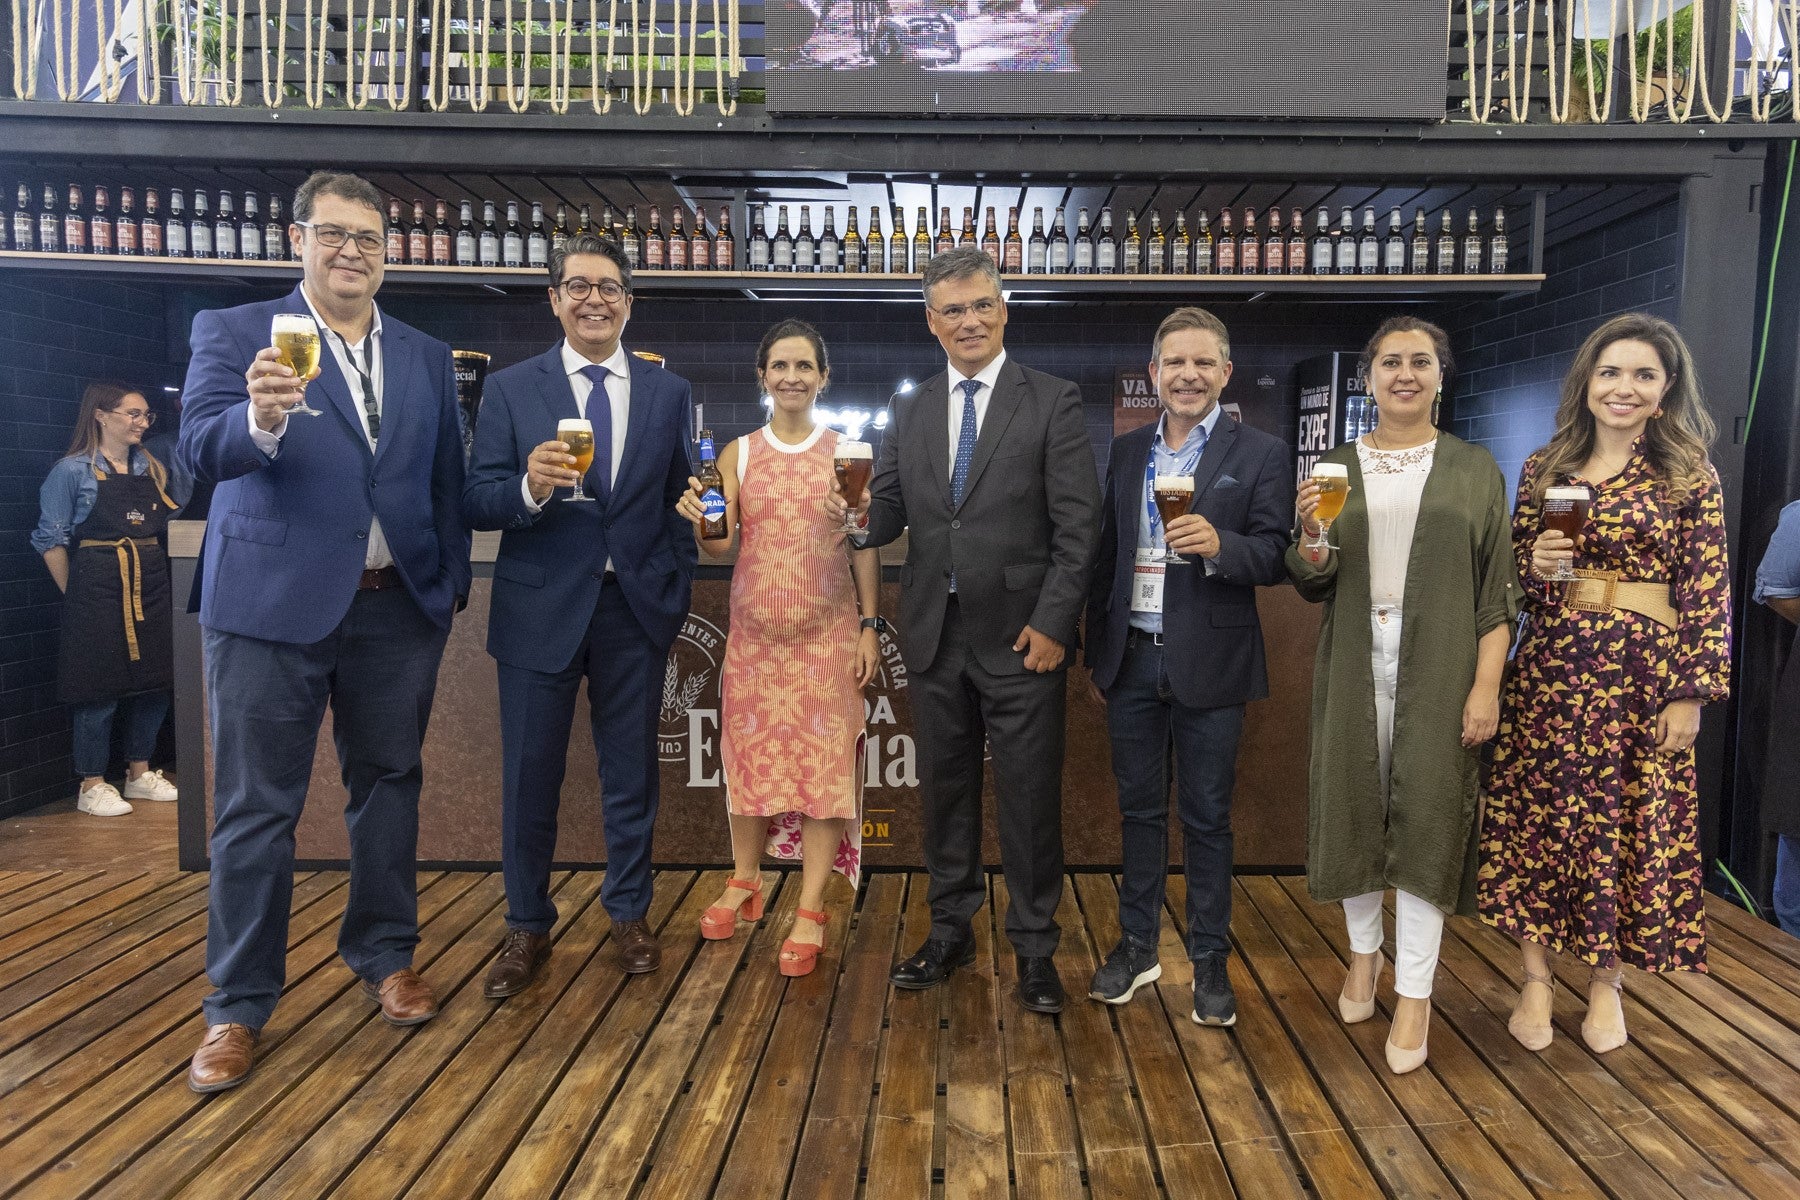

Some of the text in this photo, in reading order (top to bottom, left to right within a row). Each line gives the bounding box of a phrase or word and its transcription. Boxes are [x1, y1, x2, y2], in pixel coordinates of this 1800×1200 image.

[455, 369, 477, 381] ecial
[1122, 379, 1148, 395] VA
[1122, 396, 1163, 408] NOSOT
[1322, 392, 1329, 407] DE
[1298, 412, 1328, 452] EXPE
[703, 500, 725, 508] ORADA
[657, 741, 682, 753] CUI
